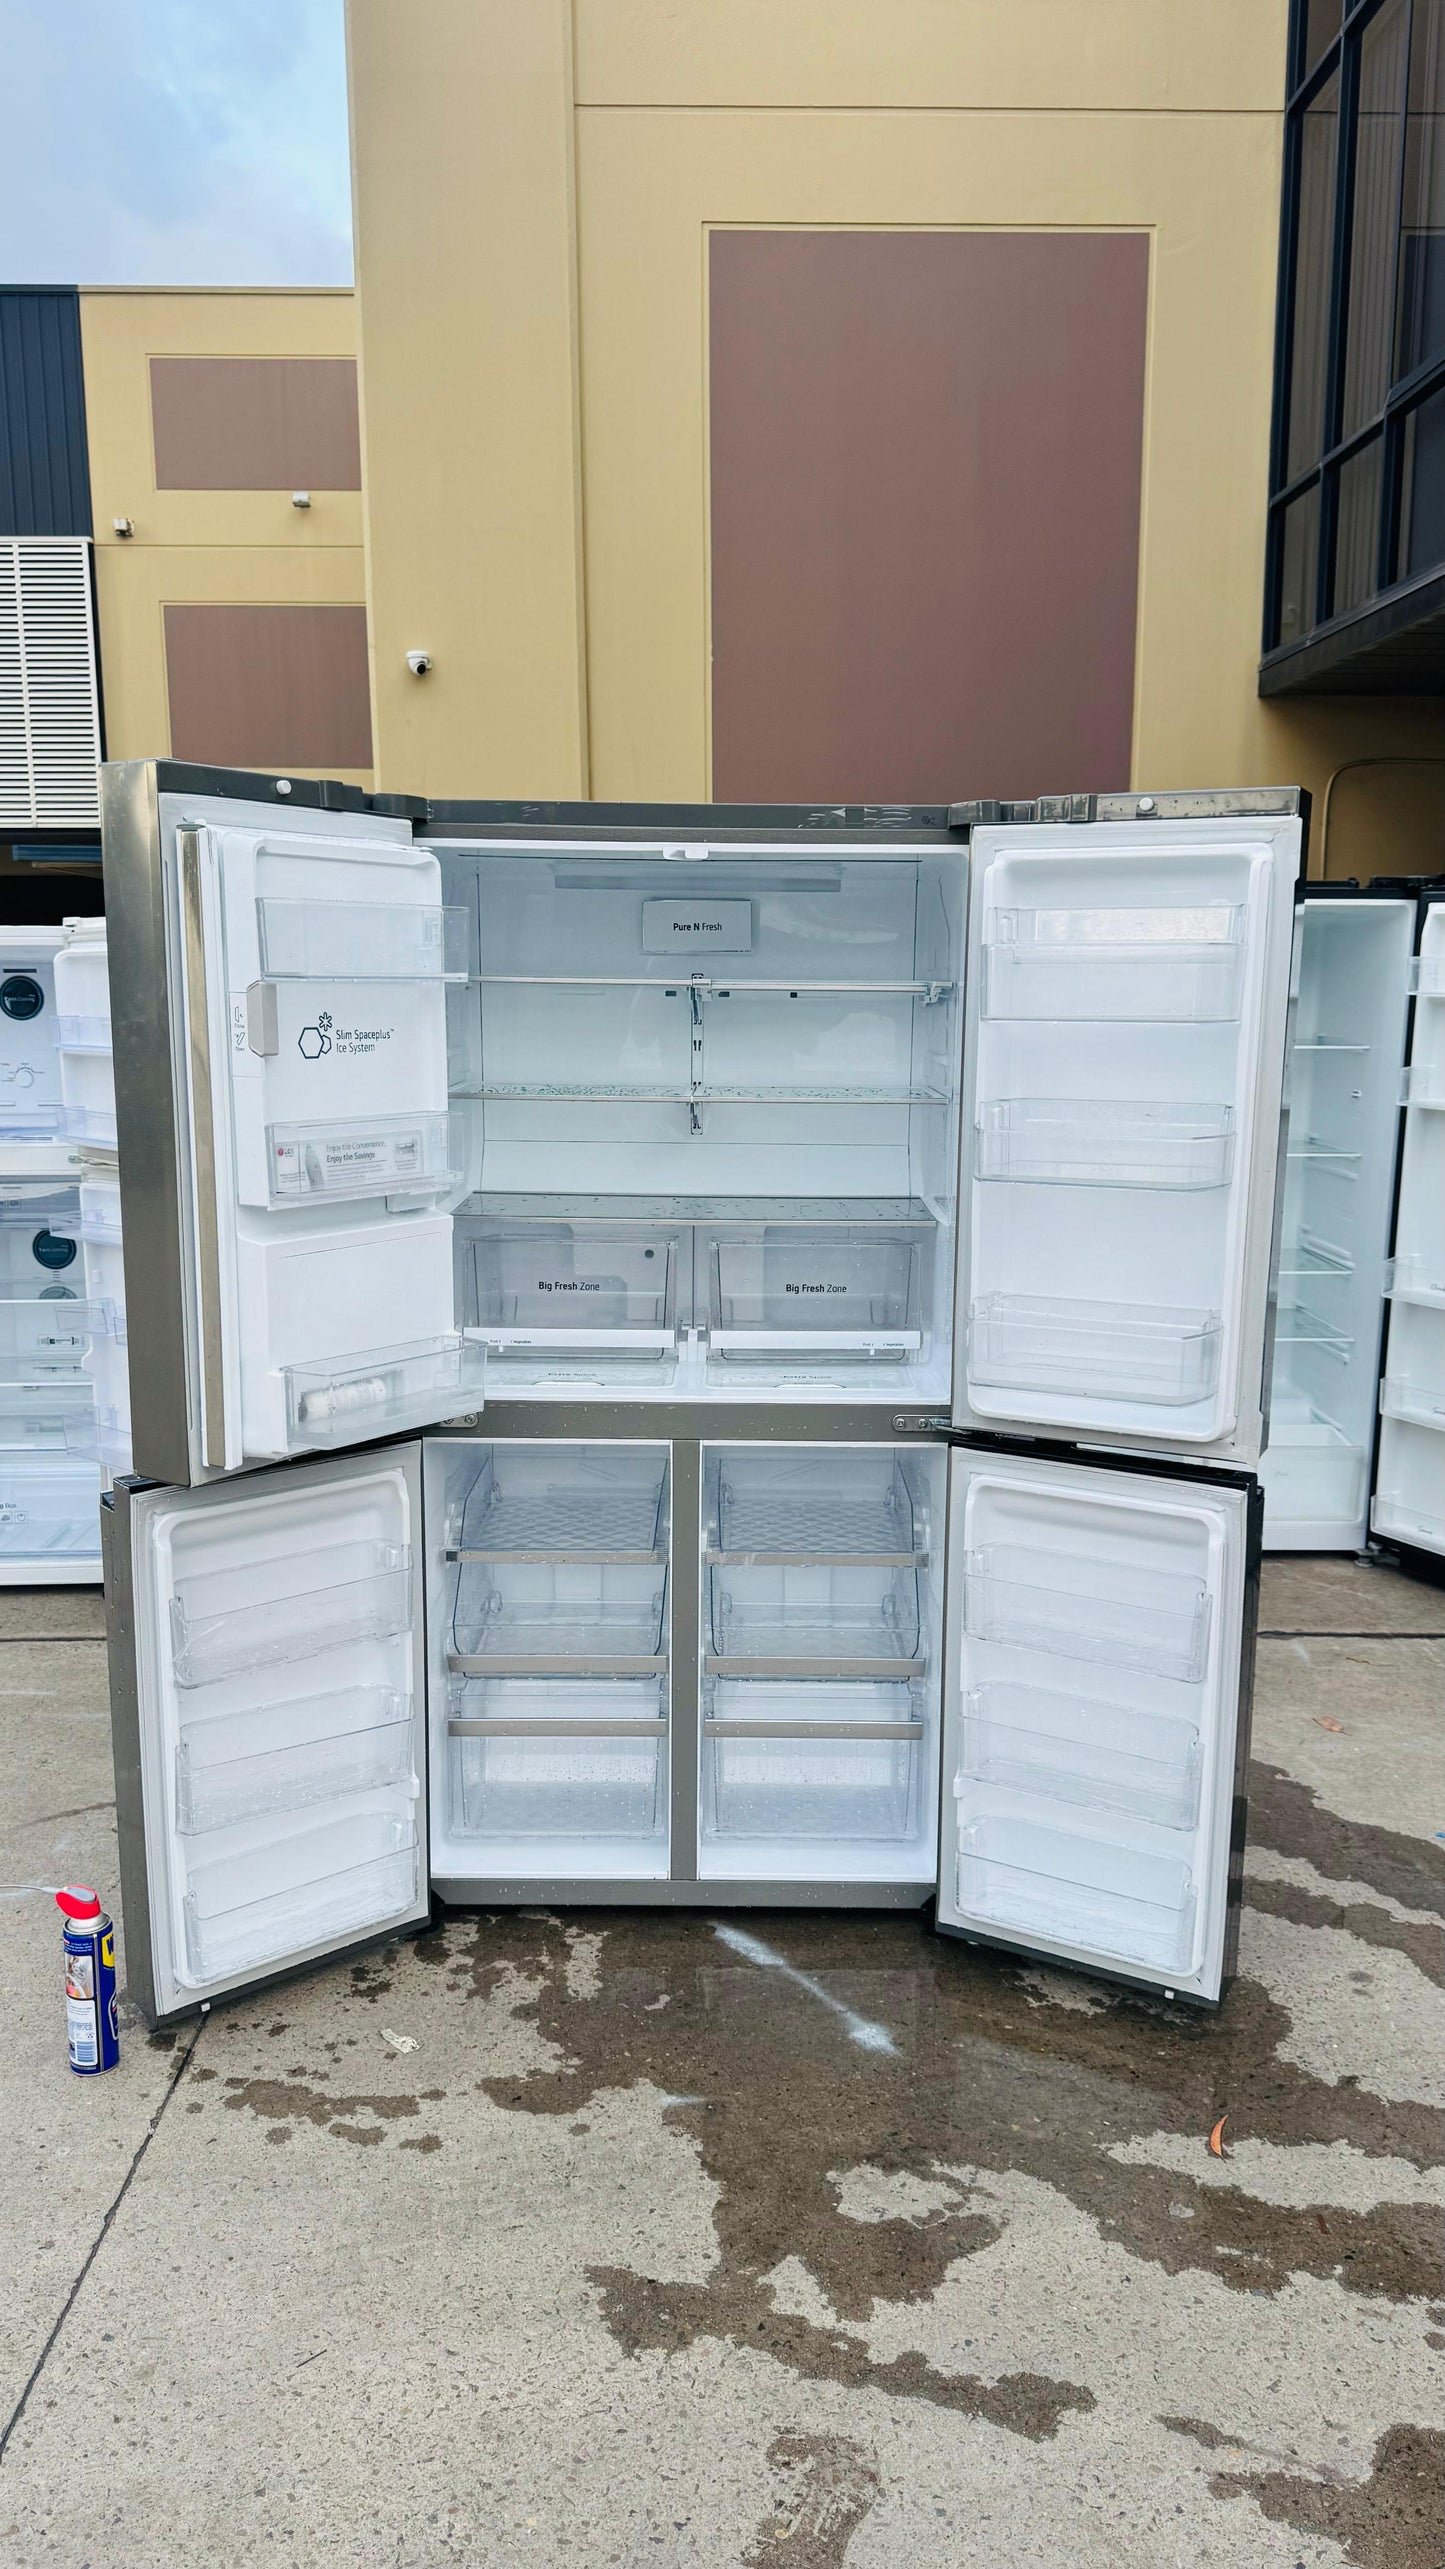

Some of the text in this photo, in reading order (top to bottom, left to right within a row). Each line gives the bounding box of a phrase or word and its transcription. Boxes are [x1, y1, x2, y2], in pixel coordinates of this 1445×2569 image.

[673, 922, 723, 931] Pure N Fresh
[336, 1029, 353, 1040] Slim
[336, 1043, 376, 1055] Ice System
[326, 1144, 342, 1154] Enjoy
[326, 1151, 376, 1164] Enjoy the Savings
[538, 1281, 600, 1292] Big Fresh Zone
[785, 1283, 848, 1295] Big Fresh Zone
